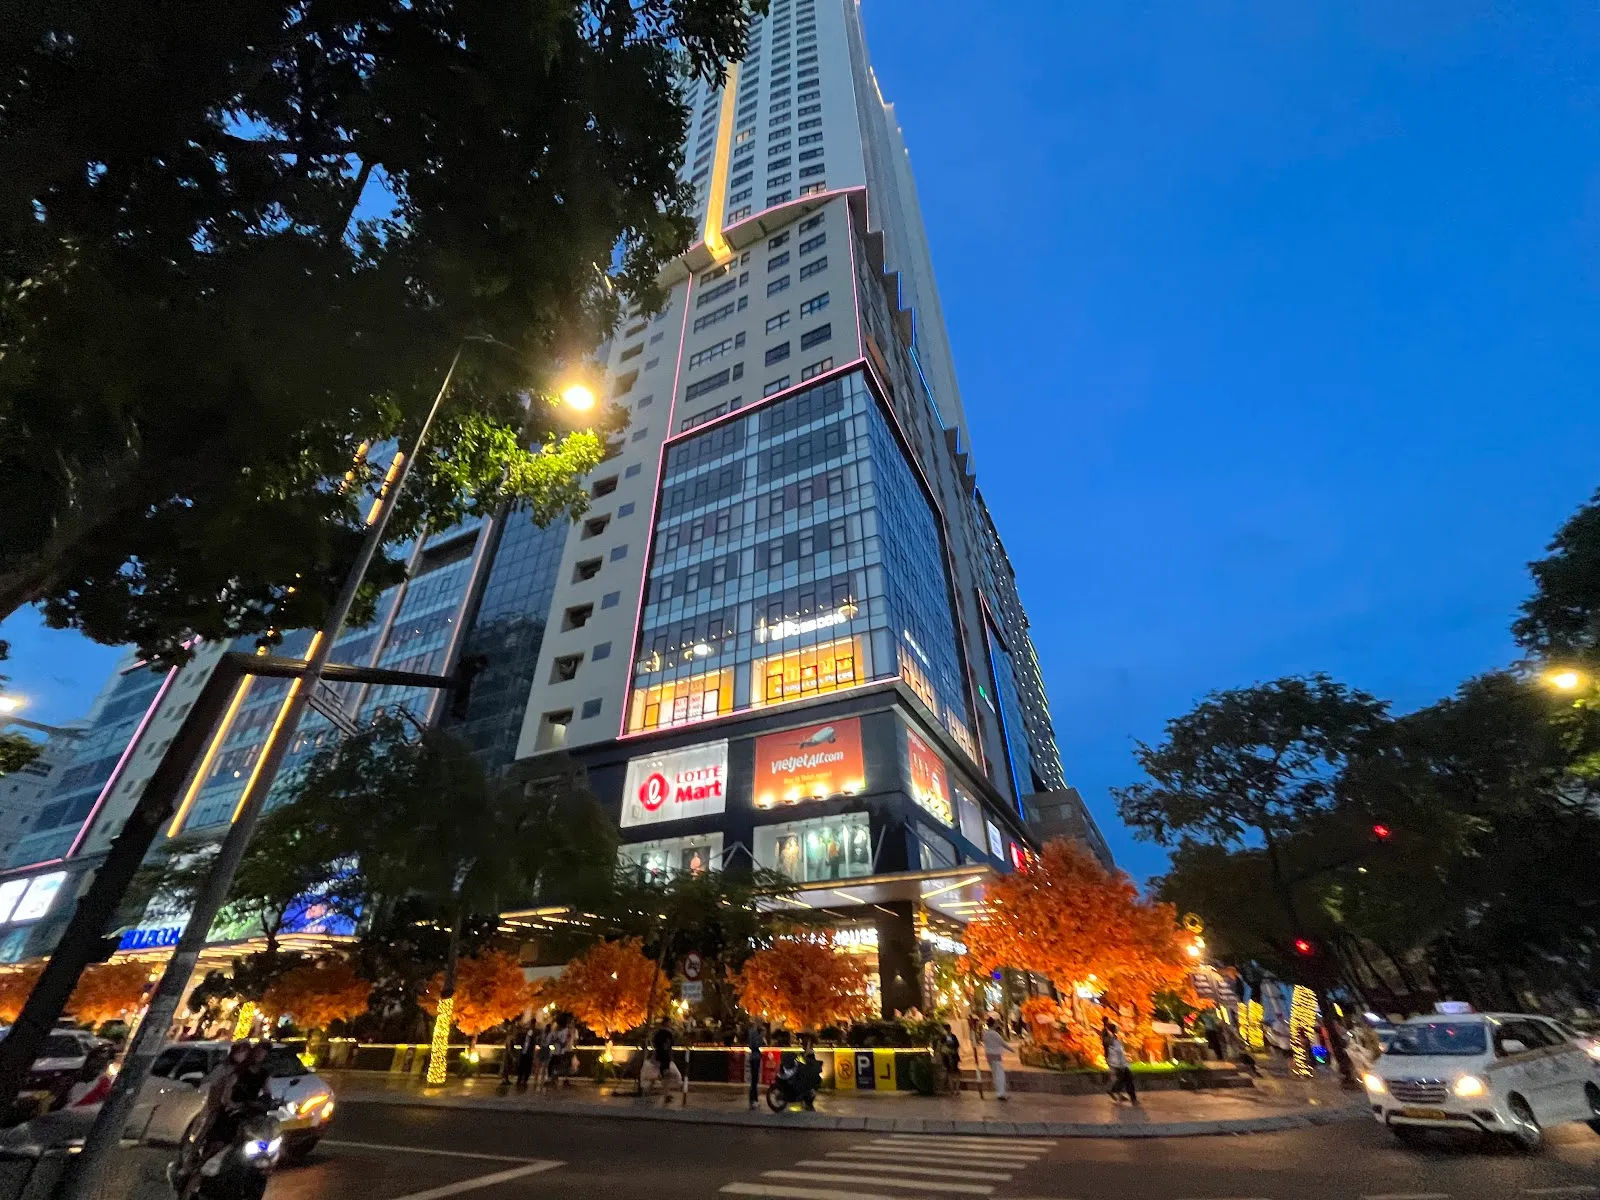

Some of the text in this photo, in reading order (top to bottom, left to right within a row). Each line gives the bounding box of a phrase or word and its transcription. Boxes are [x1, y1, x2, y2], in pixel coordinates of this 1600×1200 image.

[676, 765, 720, 783] LOTTE
[675, 780, 722, 803] Mart
[857, 1055, 870, 1075] P
